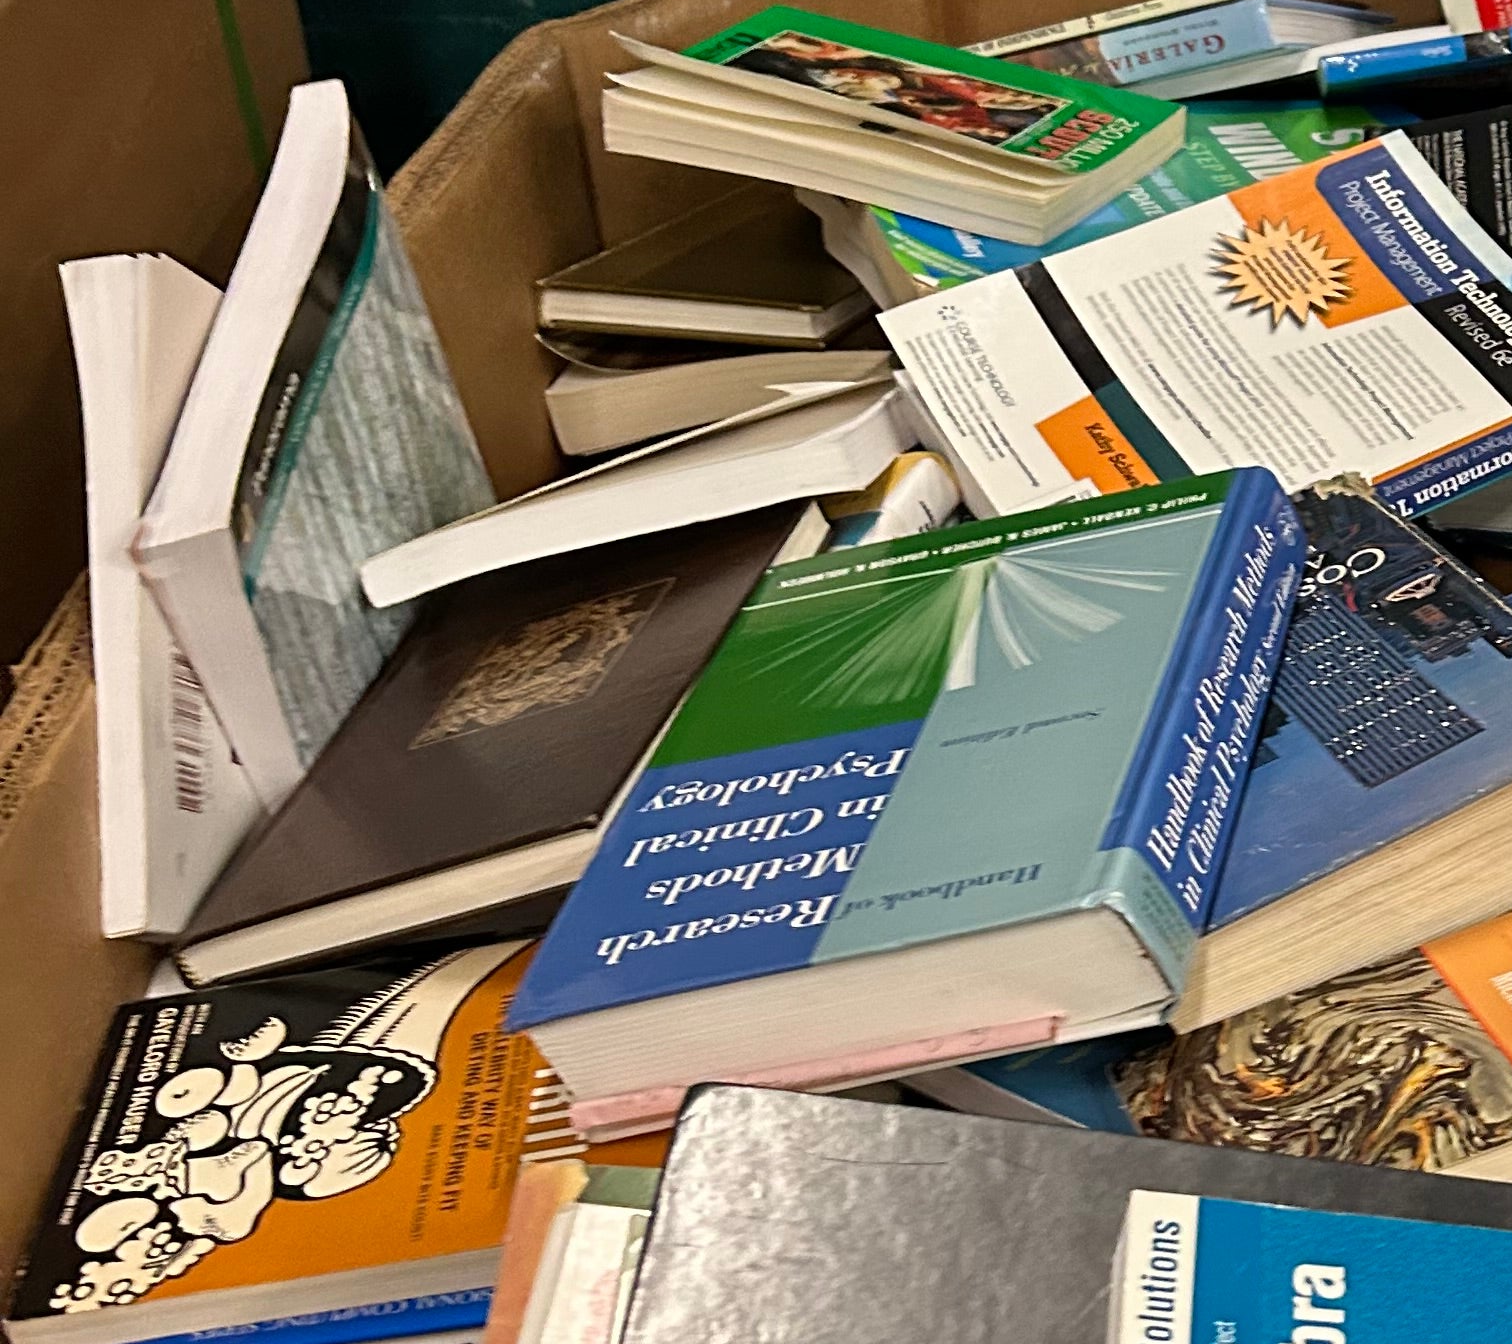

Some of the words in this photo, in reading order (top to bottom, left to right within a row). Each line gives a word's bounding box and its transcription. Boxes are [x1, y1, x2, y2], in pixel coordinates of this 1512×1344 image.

[1101, 117, 1141, 137] 250
[1127, 184, 1165, 218] PDATE
[1365, 170, 1459, 274] Information
[1339, 180, 1378, 225] Project
[1370, 220, 1444, 297] Management
[1445, 304, 1497, 352] Revised
[1085, 422, 1113, 457] Kathy
[1109, 452, 1140, 488] Schwa
[1232, 524, 1275, 617] Methods
[1300, 547, 1386, 597] COS
[1200, 607, 1248, 714] Research
[1195, 698, 1216, 743] of
[1215, 650, 1272, 779] Psychology
[639, 748, 909, 814] Psychology
[838, 793, 895, 824] in
[1147, 732, 1209, 871] Handbook
[624, 806, 824, 869] Clinical
[1187, 765, 1236, 875] Clinical
[645, 846, 868, 905] Methods
[870, 863, 1041, 913] Handbook
[1176, 875, 1203, 913] in
[597, 893, 842, 964] Research
[836, 896, 865, 922] of
[137, 1007, 179, 1082] GAYELORD
[465, 1031, 489, 1086] DIETING
[485, 1036, 511, 1094] LEBRITY
[114, 1085, 155, 1145] HAUSER
[458, 1091, 480, 1120] AND
[477, 1099, 499, 1127] WAY
[444, 1124, 472, 1186] KEEPING
[474, 1134, 493, 1150] OF
[440, 1189, 461, 1211] FIT
